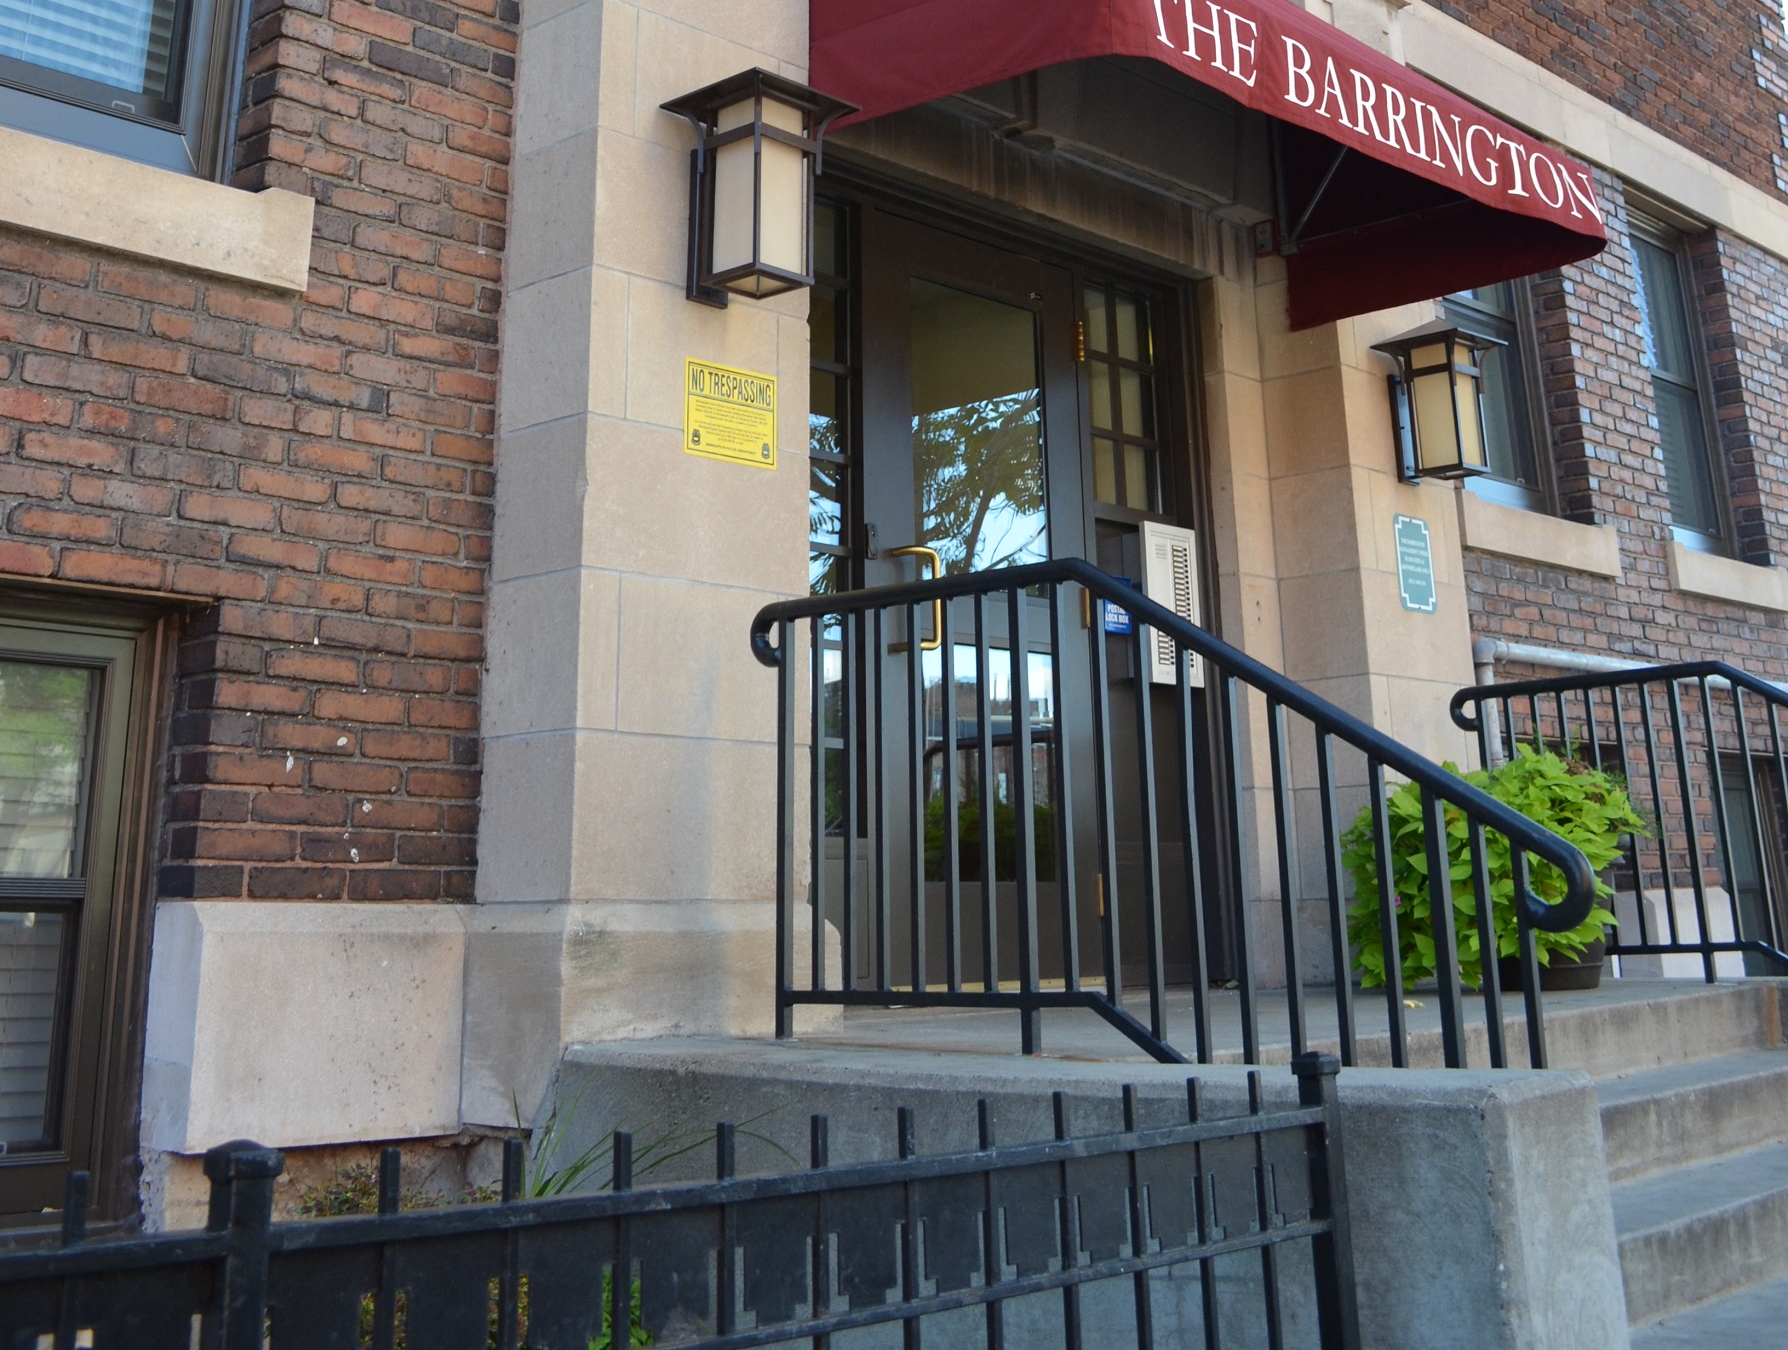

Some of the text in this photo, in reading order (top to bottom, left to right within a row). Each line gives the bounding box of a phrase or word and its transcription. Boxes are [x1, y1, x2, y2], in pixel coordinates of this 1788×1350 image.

[1280, 34, 1603, 225] BARRINGTON
[691, 367, 771, 406] NO TRESPASSING
[1105, 612, 1129, 624] LOCK BOX
